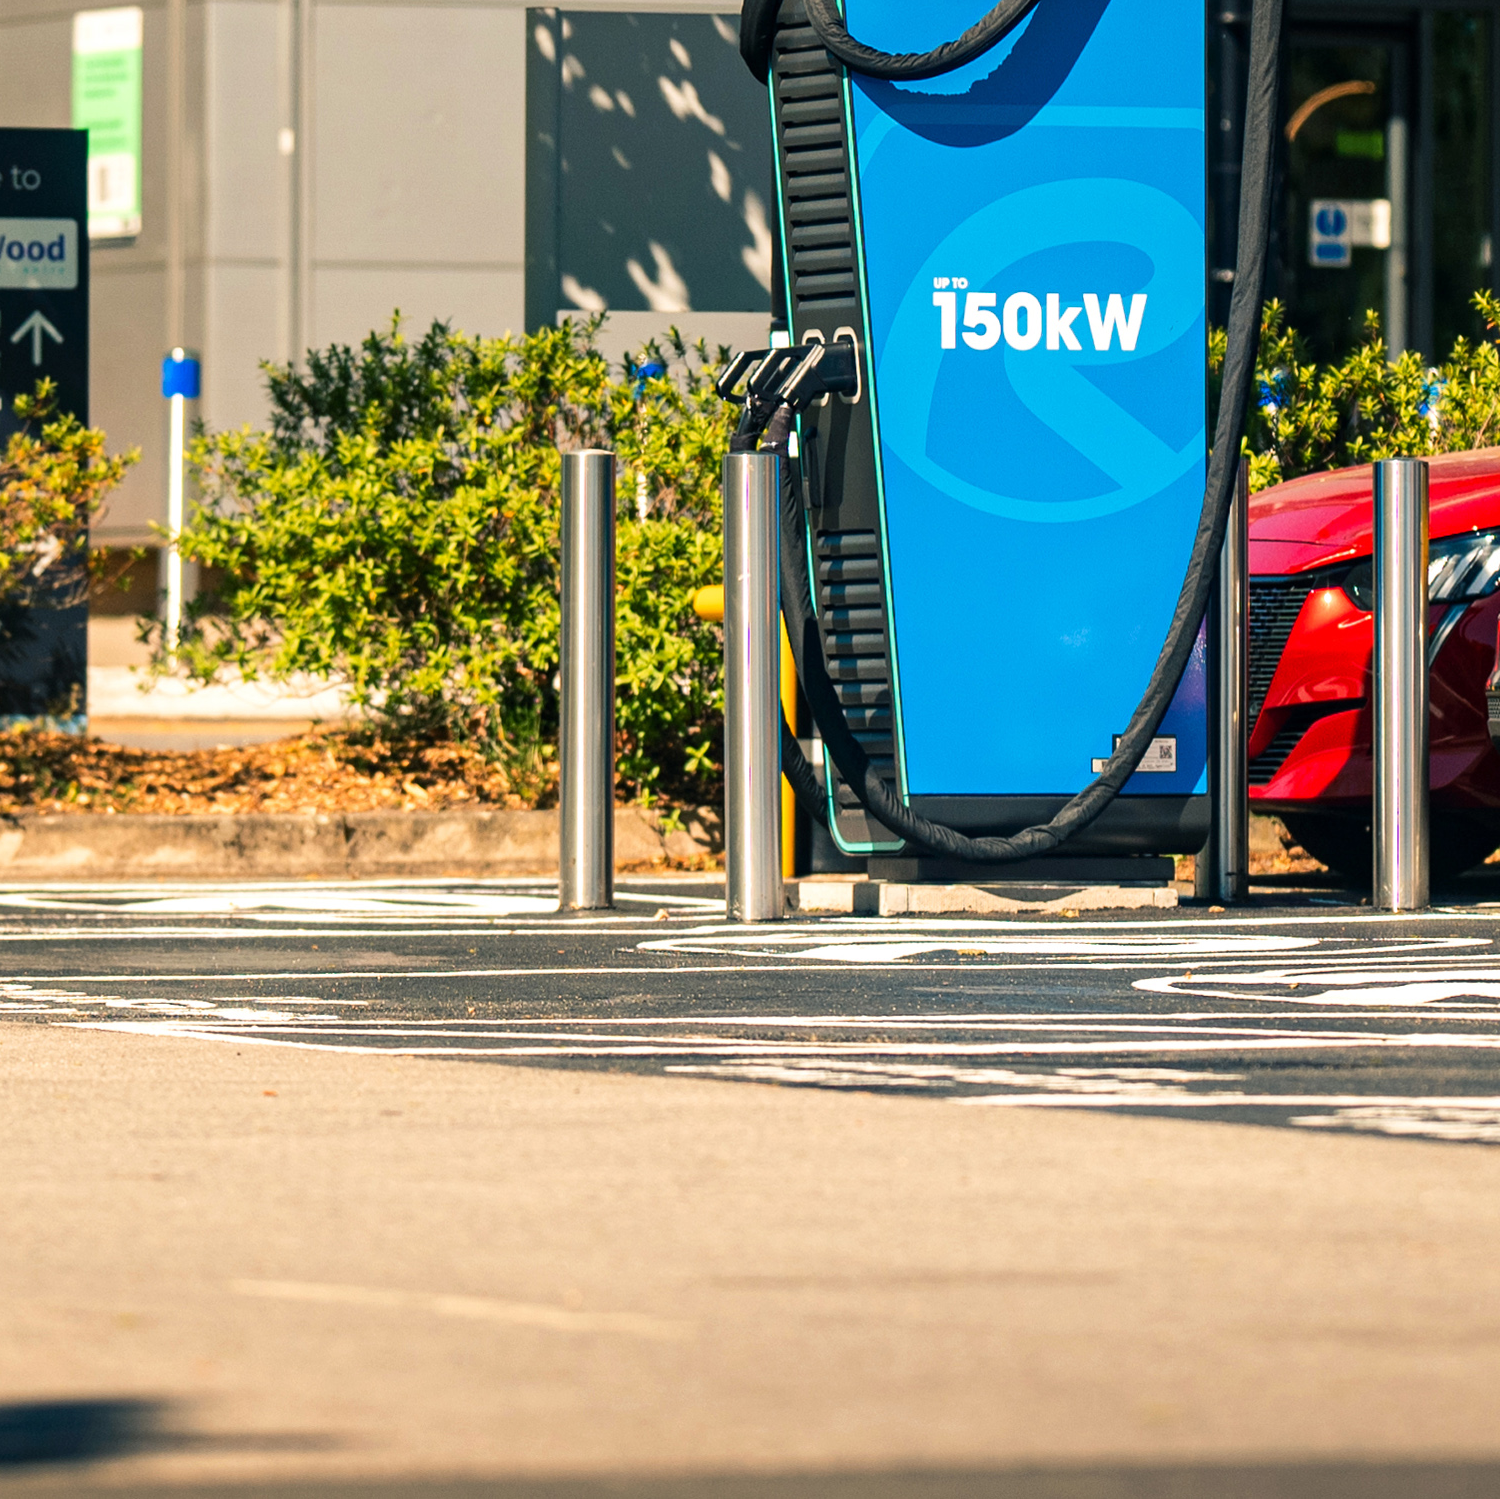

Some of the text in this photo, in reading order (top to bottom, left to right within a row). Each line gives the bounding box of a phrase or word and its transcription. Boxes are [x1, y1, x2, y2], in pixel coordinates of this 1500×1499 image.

[10, 165, 41, 190] to
[933, 277, 968, 289] UP TO
[933, 291, 1148, 351] 150kW
